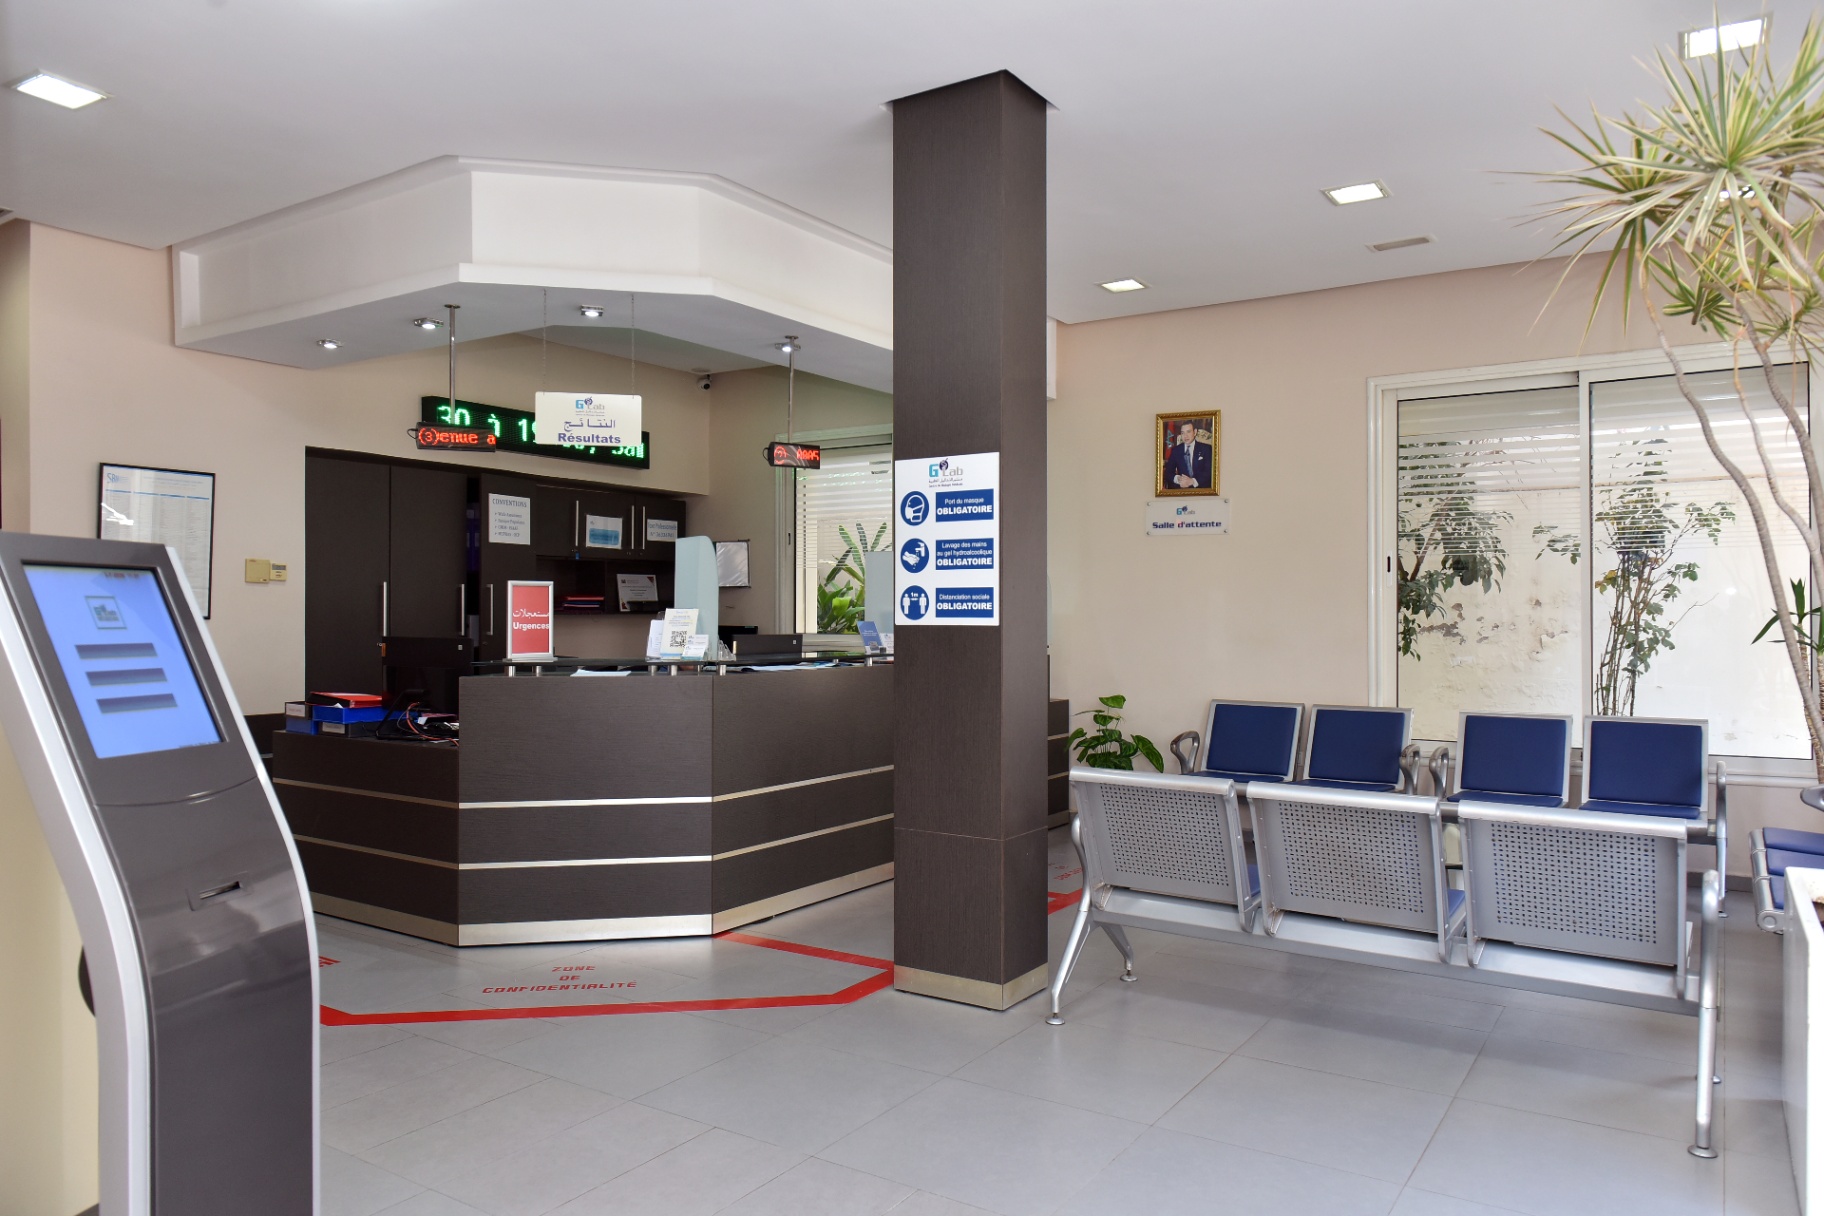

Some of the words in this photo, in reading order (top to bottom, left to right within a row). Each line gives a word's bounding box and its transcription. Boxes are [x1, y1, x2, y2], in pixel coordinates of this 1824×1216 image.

[575, 399, 584, 410] G
[557, 432, 622, 444] Résultats
[928, 463, 939, 477] G
[942, 466, 964, 477] Lab
[492, 498, 528, 508] CONVENTIONS
[963, 497, 985, 505] masque
[936, 505, 993, 515] OBLIGATOIRE
[1152, 521, 1175, 529] Salle
[1177, 521, 1222, 529] d'attente
[943, 550, 953, 558] gel
[936, 557, 993, 566] OBLIGATOIRE
[936, 602, 993, 610] OBLIGATOIRE
[512, 621, 550, 632] Urgences
